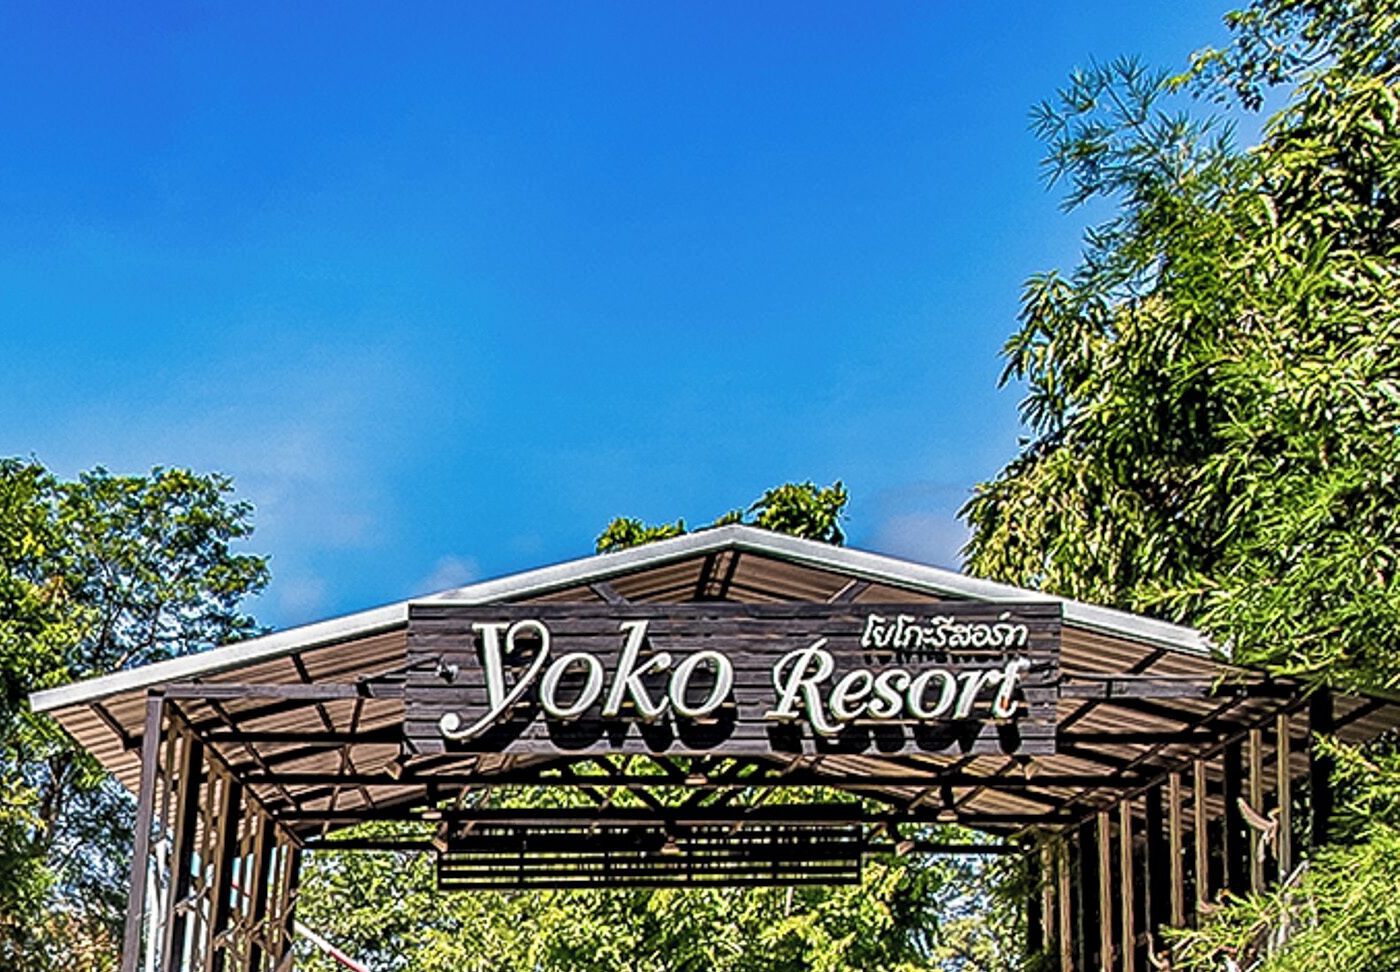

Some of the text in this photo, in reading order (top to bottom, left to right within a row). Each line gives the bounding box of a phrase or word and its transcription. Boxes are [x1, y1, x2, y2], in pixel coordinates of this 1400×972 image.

[861, 612, 1028, 647] โยโกะรีสอร์ท
[439, 619, 1030, 740] Yoko Resort
